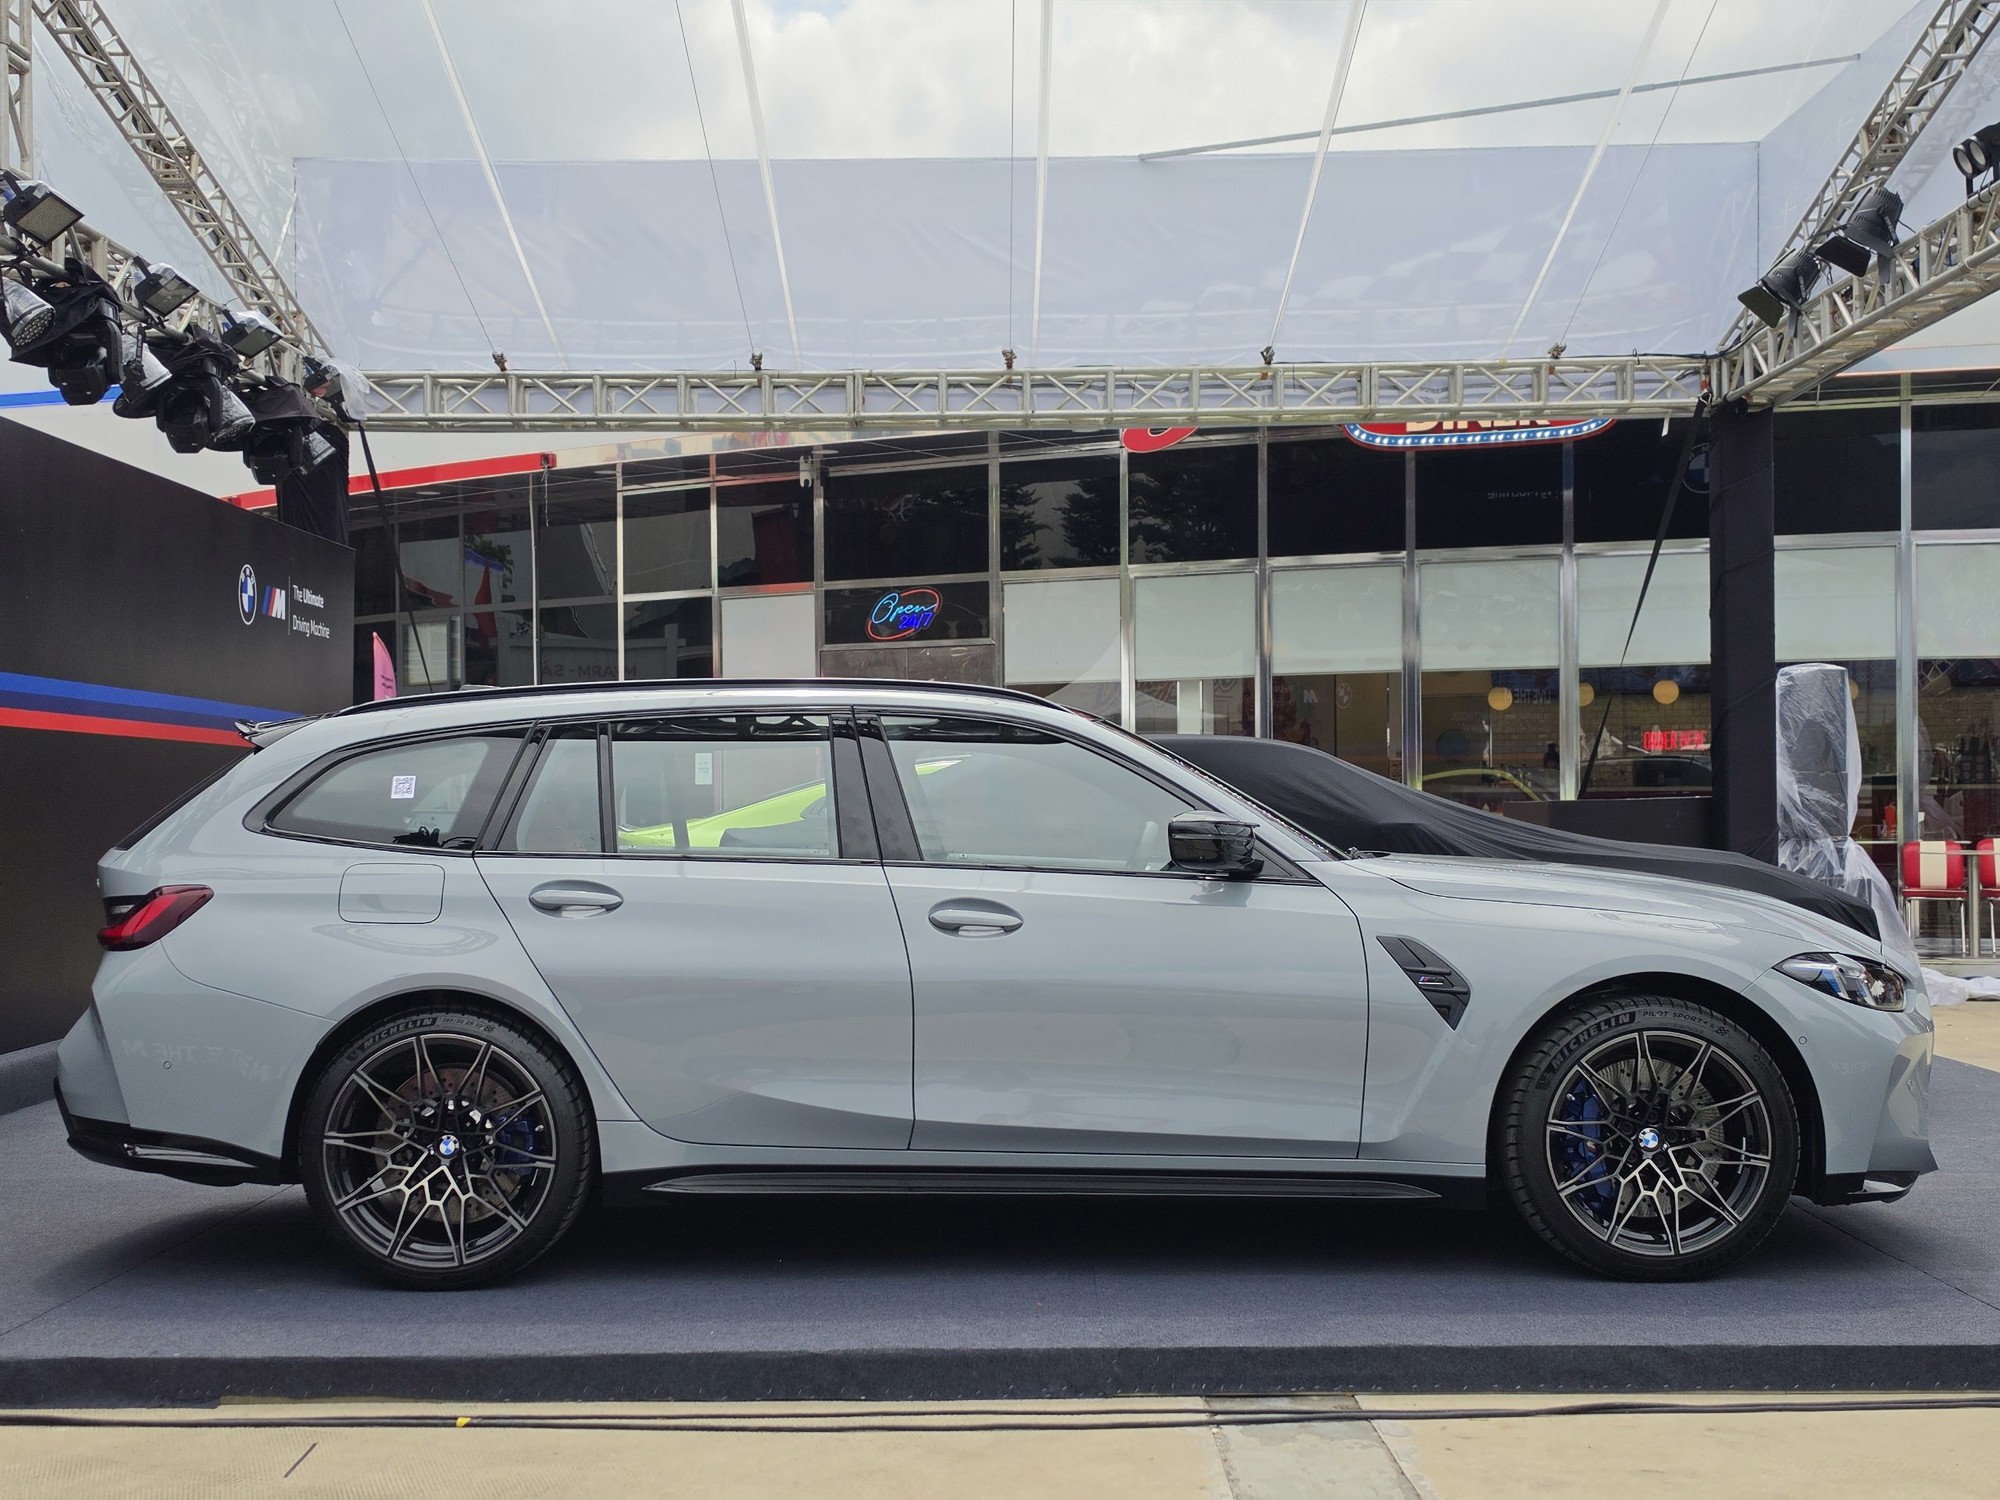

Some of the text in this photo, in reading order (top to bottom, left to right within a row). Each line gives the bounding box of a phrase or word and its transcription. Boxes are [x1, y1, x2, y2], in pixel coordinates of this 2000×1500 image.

[293, 584, 324, 608] The Ultimate
[872, 592, 938, 624] Open
[292, 614, 330, 639] Driving Machine
[898, 612, 933, 629] 24/7
[1643, 730, 1678, 751] ORDER
[363, 1017, 434, 1049] MICHELIN
[1551, 1012, 1631, 1070] MICHELIN
[1672, 1011, 1703, 1024] SPORT
